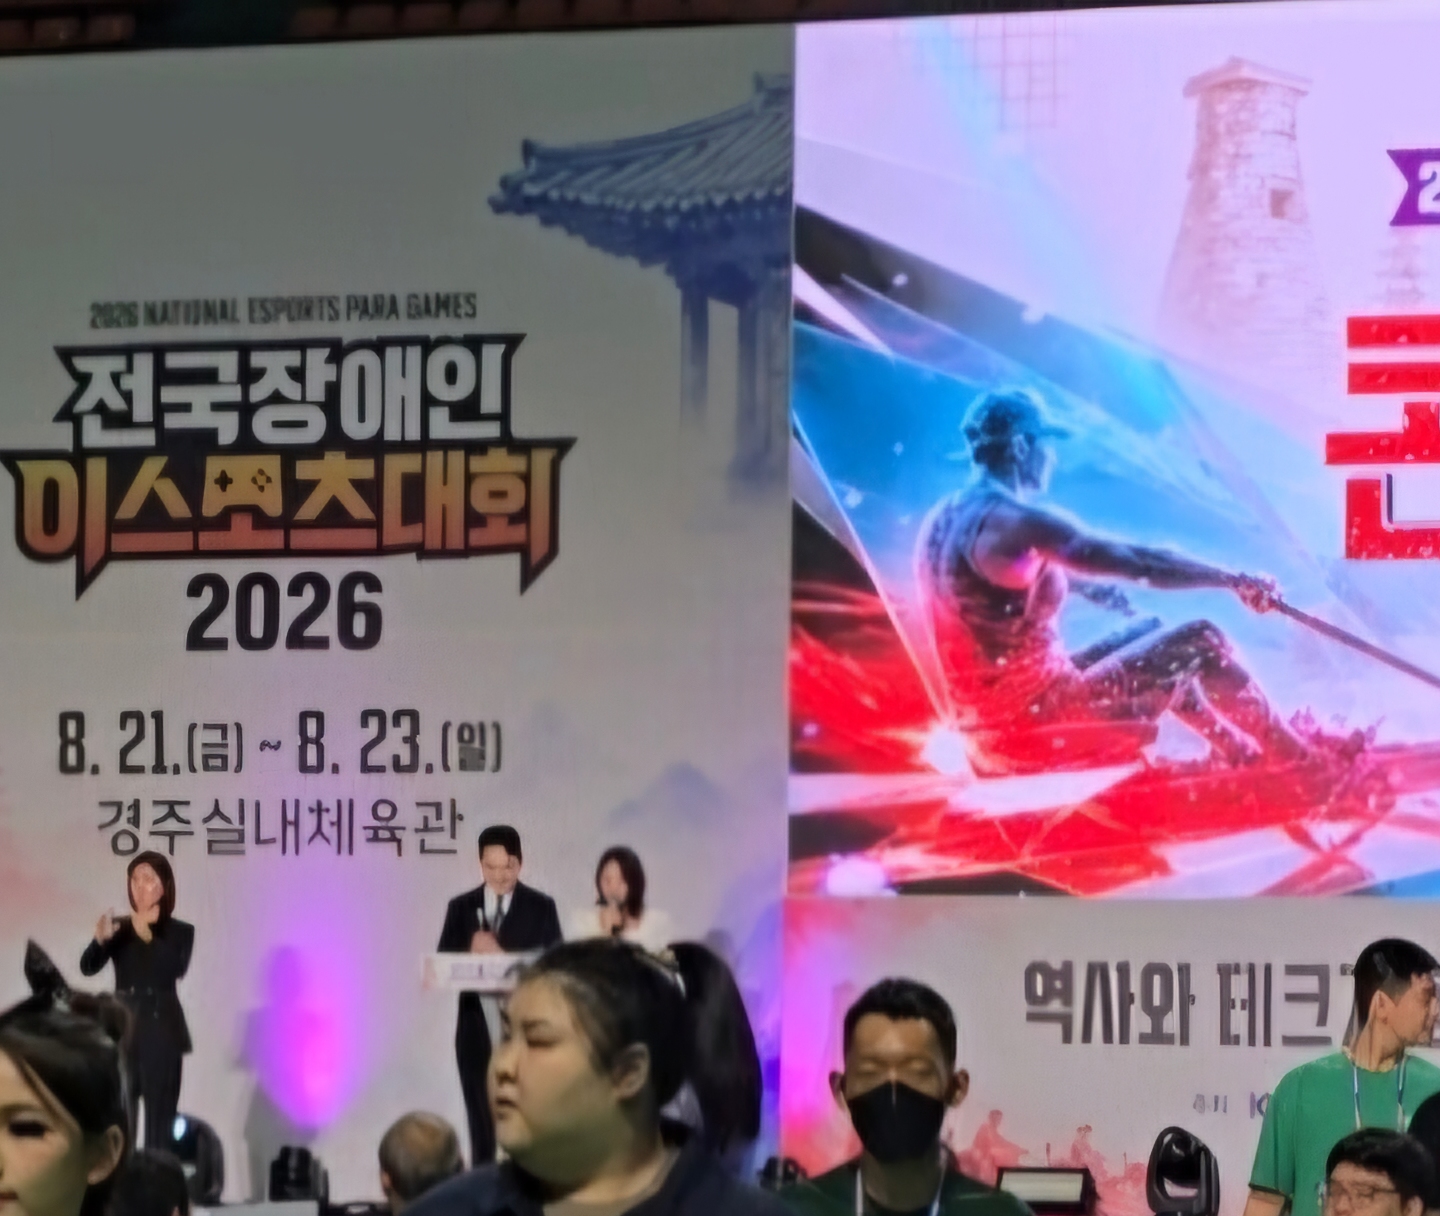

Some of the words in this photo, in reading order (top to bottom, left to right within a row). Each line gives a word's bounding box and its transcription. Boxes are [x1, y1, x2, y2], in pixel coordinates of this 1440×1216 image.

[89, 302, 139, 329] 2026
[143, 298, 241, 327] NATIONAL
[247, 295, 341, 325] ESPORTS
[345, 294, 401, 322] PARA
[406, 291, 478, 321] GAMES
[70, 341, 510, 447] 전국장애인
[13, 448, 556, 577] 이스포츠대회
[185, 571, 384, 652] 2026
[57, 710, 101, 776] 8.
[258, 738, 282, 754] ~
[296, 710, 340, 776] 8.
[97, 797, 466, 858] 경주실내체육관
[1023, 960, 1197, 1047] 역사와
[1217, 962, 1355, 1048] 테크
